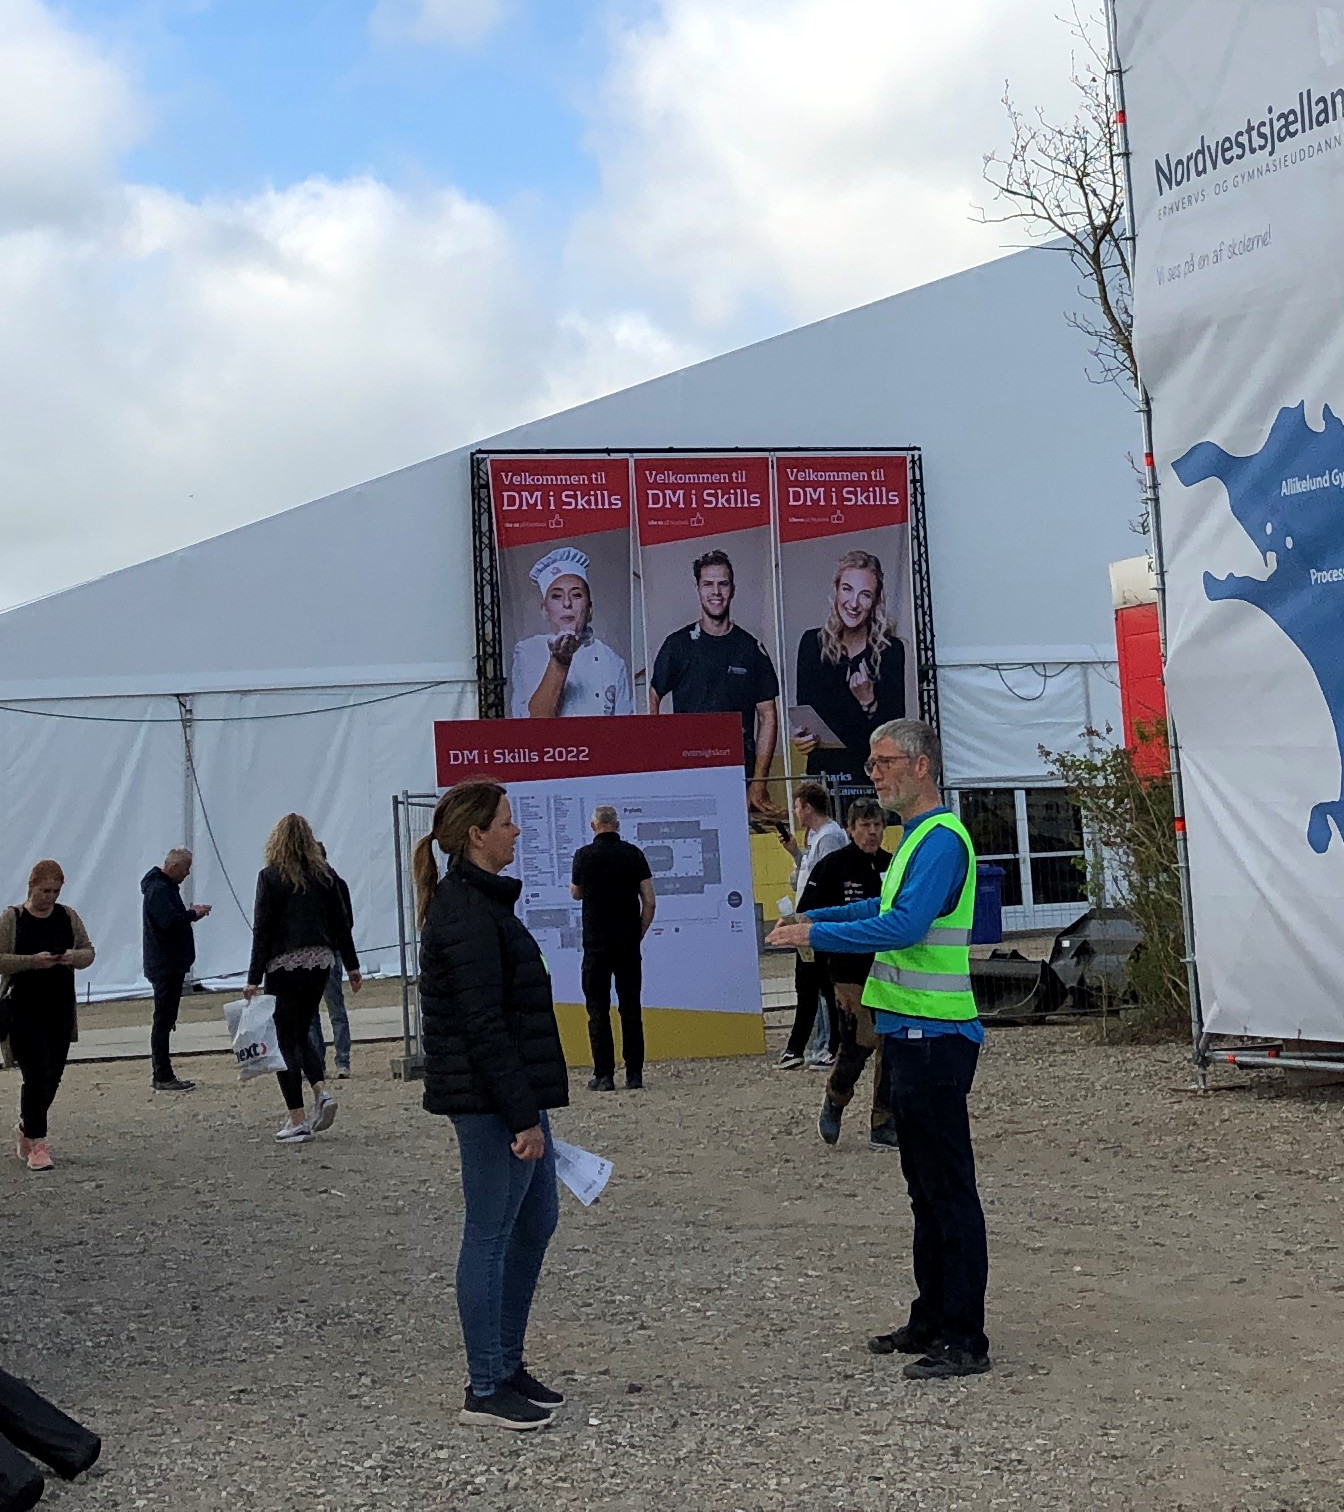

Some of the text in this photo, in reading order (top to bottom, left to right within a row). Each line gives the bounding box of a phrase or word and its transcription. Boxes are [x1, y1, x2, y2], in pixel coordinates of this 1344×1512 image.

[1213, 178, 1229, 196] OG
[1168, 263, 1182, 283] ses
[1183, 252, 1195, 280] på
[1212, 240, 1225, 265] af
[500, 471, 607, 486] Velkommen til
[644, 469, 747, 485] Velkommen til
[786, 468, 886, 482] Velkommen til
[1280, 469, 1331, 496] Allikelund
[501, 490, 623, 511] DM i Skills
[646, 488, 762, 509] DM i Skills
[788, 486, 900, 506] DM i Skills
[448, 746, 590, 765] DM i Skills 2022
